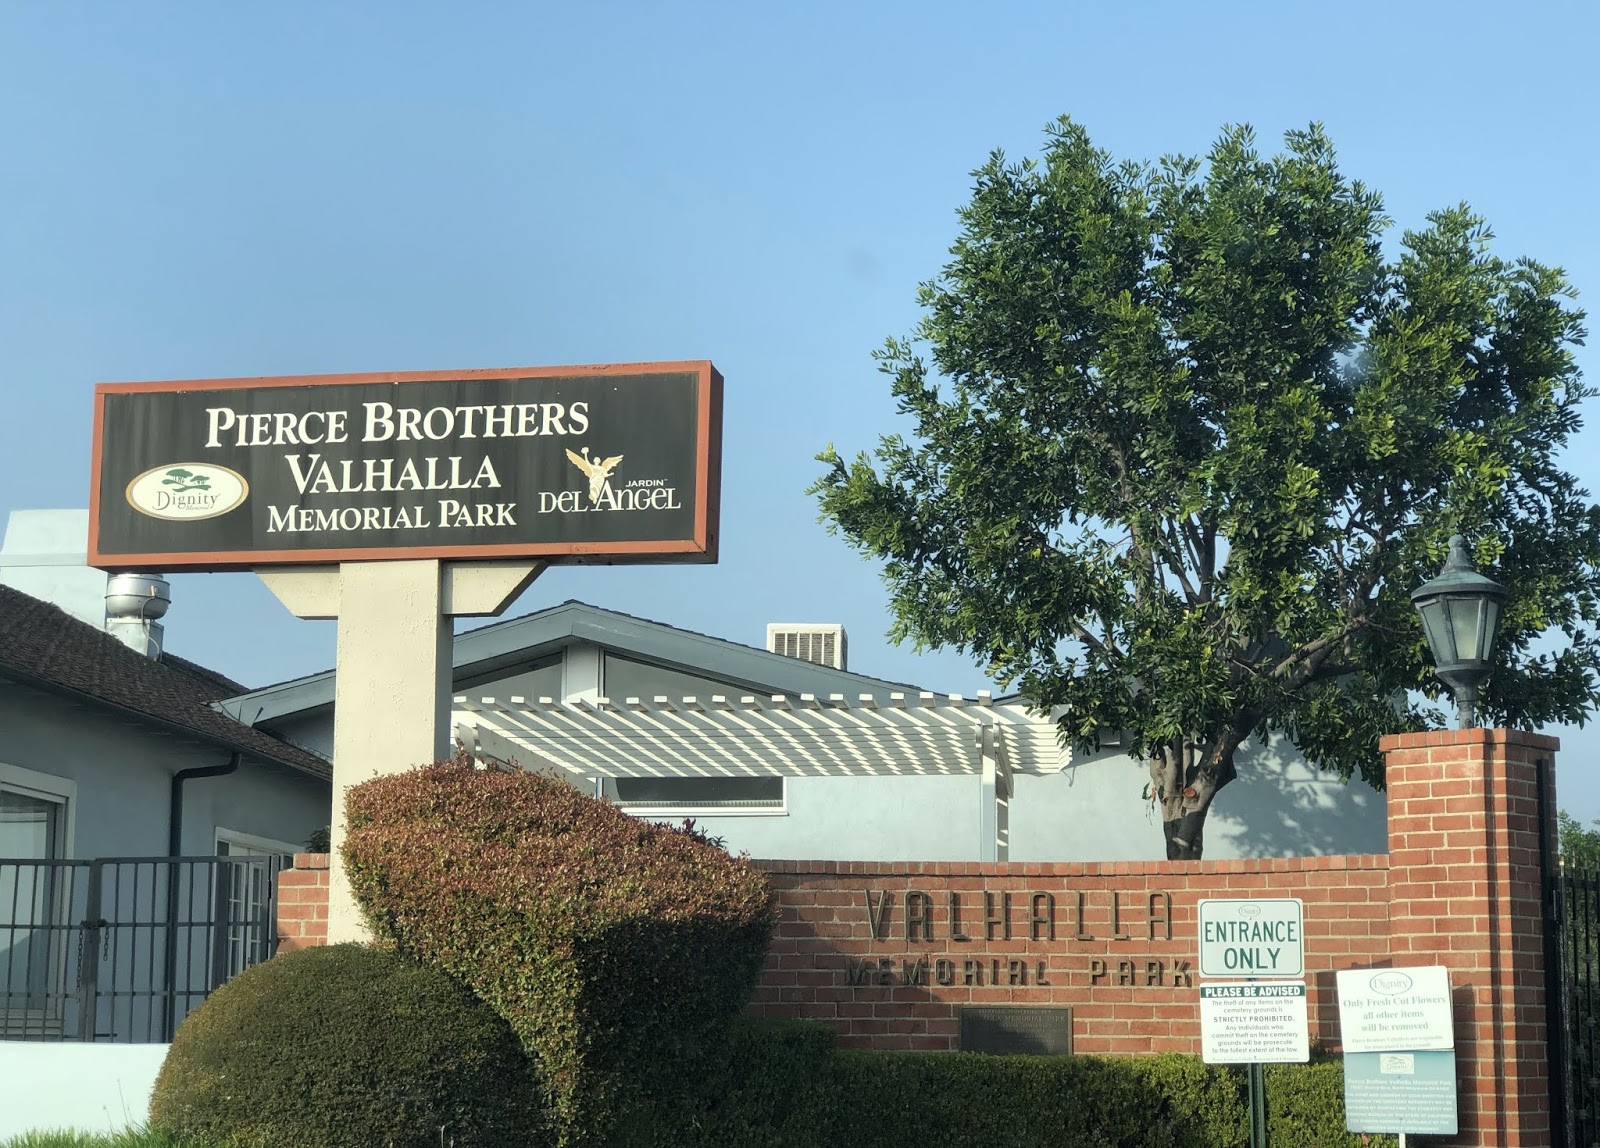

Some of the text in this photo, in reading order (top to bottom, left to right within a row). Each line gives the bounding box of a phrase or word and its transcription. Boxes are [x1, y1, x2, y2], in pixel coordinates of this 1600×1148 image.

[205, 400, 590, 448] PIERCE BROTHERS
[284, 453, 502, 496] VALHALLA
[625, 479, 664, 488] JARDIN
[152, 491, 218, 511] Dignity
[267, 501, 518, 534] MEMORIAL PARK
[864, 888, 1171, 941] VALHALLA
[1205, 921, 1298, 943] ENTRANCE
[1224, 947, 1281, 969] ONLY
[846, 956, 1192, 987] MEMORIAL PARK
[1205, 986, 1301, 997] PLEASE BE ADVISED
[1374, 978, 1408, 990] Dignity
[1343, 996, 1446, 1008] Only Fresh Cut Flowers
[1249, 1015, 1296, 1023] PROHIBITED.
[1362, 1010, 1424, 1020] all other items
[1361, 1022, 1429, 1032] will be removed
